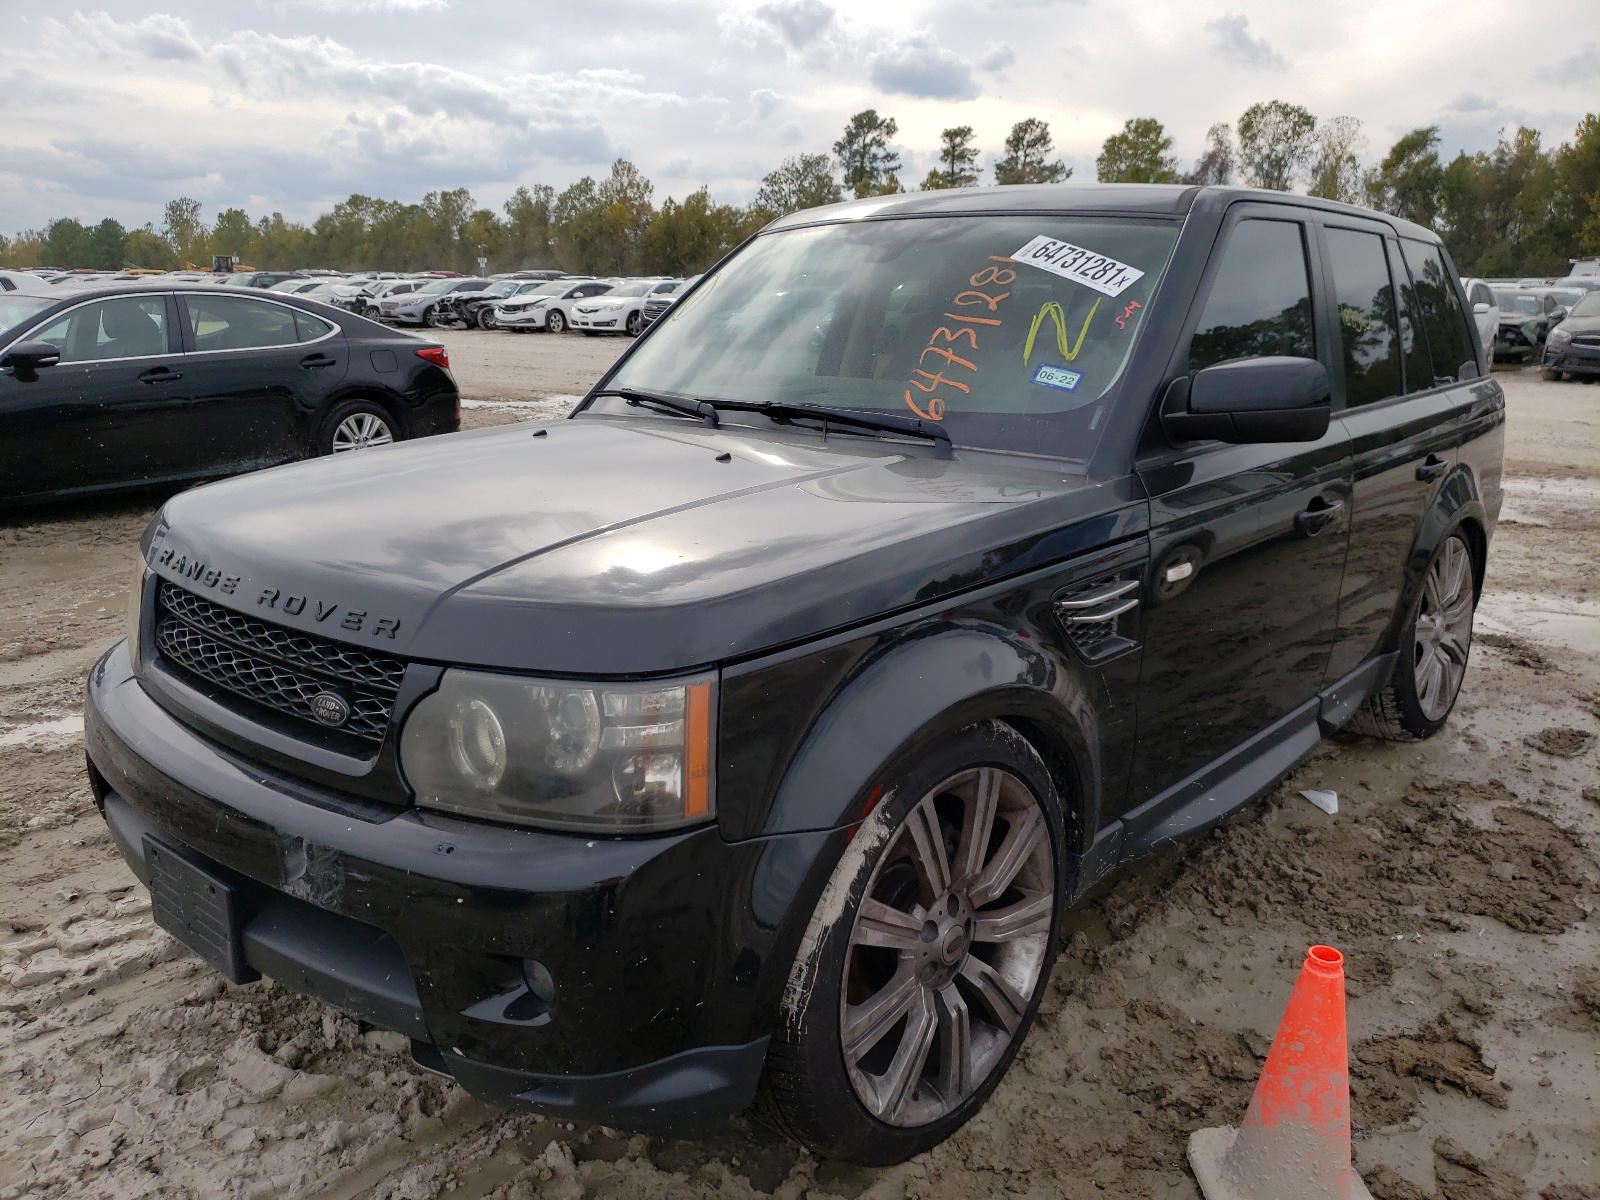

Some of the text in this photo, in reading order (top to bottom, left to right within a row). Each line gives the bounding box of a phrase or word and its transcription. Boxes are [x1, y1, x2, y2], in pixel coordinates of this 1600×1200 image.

[904, 256, 1019, 421] 64731281
[1039, 370, 1075, 385] 06-22
[160, 549, 401, 640] RANGE ROVER
